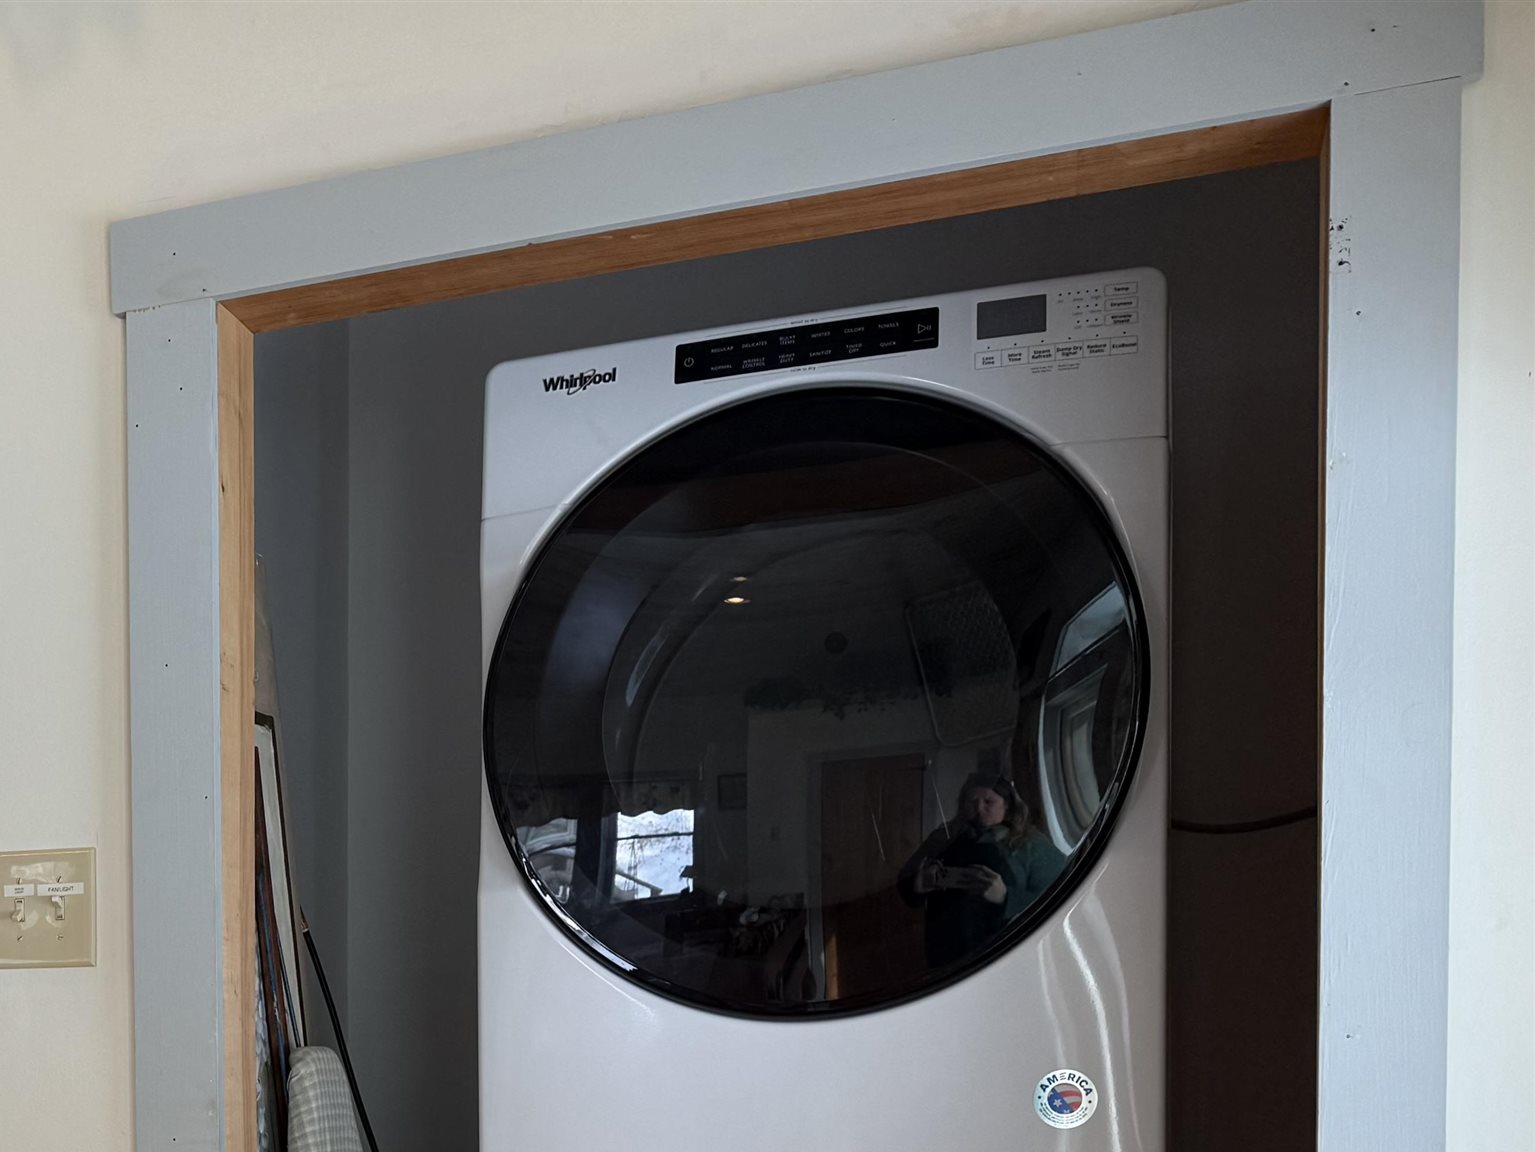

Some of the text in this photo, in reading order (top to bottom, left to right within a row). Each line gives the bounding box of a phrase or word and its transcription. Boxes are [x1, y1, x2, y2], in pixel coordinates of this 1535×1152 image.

[843, 326, 865, 334] COLORS
[741, 340, 768, 349] DELICATES
[879, 340, 897, 348] QUICK
[542, 367, 617, 395] Whirlpool
[1039, 1072, 1093, 1096] AMERICA
